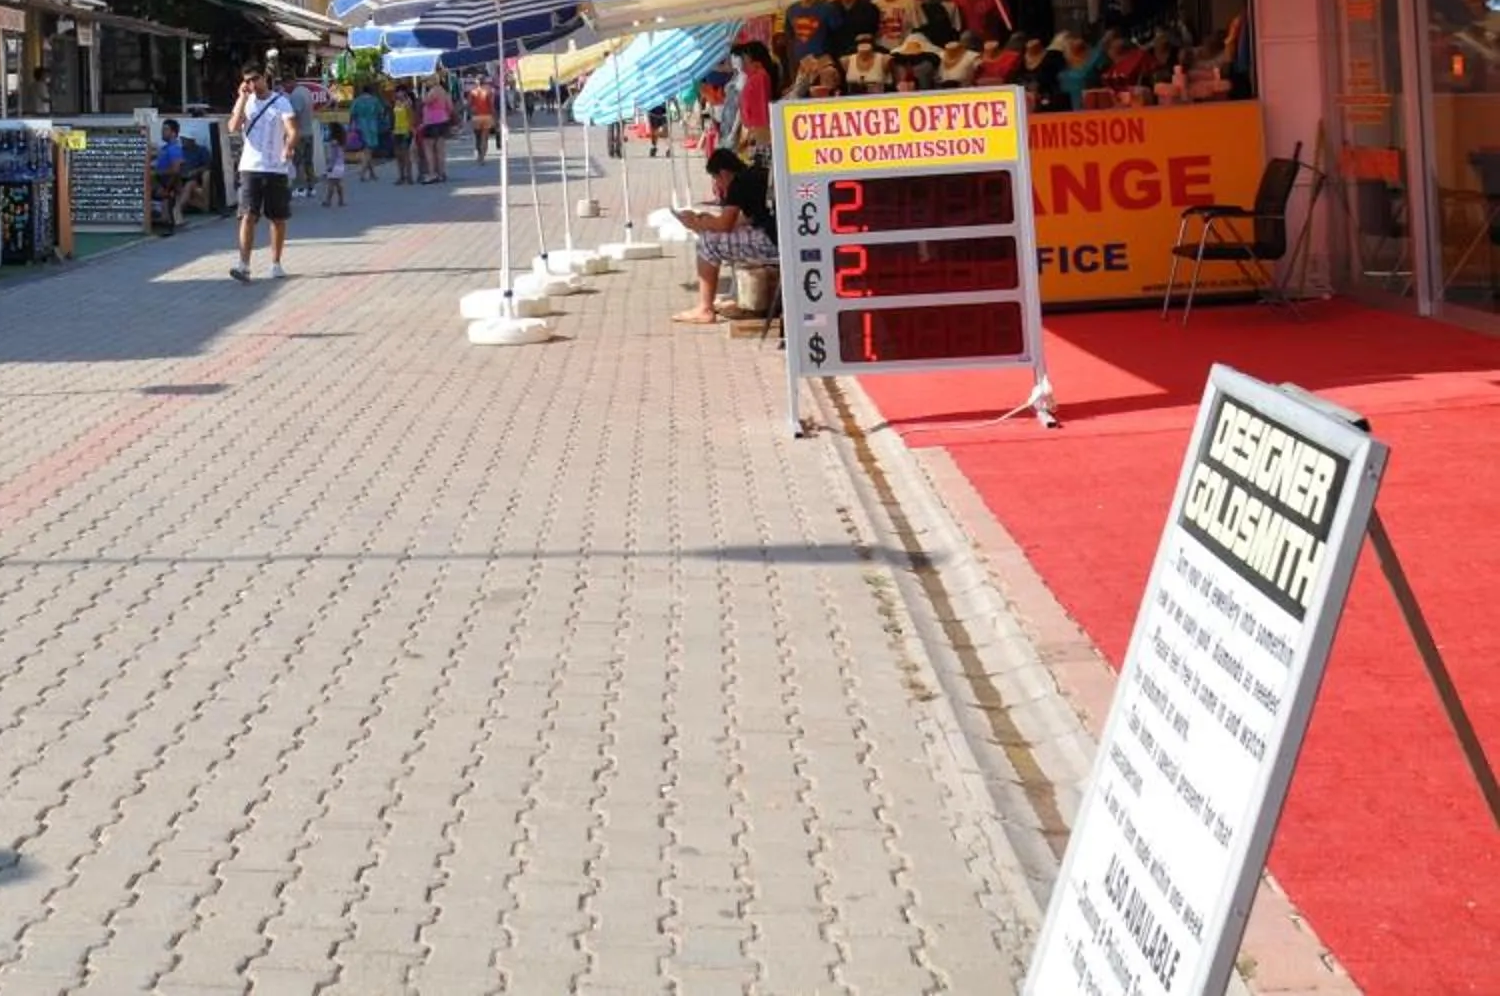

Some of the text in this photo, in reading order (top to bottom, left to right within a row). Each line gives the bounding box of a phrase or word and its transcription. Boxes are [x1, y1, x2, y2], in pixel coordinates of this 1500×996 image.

[791, 100, 1009, 141] CHANGE OFFICE
[1028, 117, 1145, 151] MMISSION
[815, 137, 986, 165] NO COMMISSION
[1036, 243, 1129, 274] FICE
[1209, 401, 1337, 525] DESIGNER
[1184, 462, 1327, 608] GOLDSMITH
[1122, 886, 1180, 993] AVAILABLE
